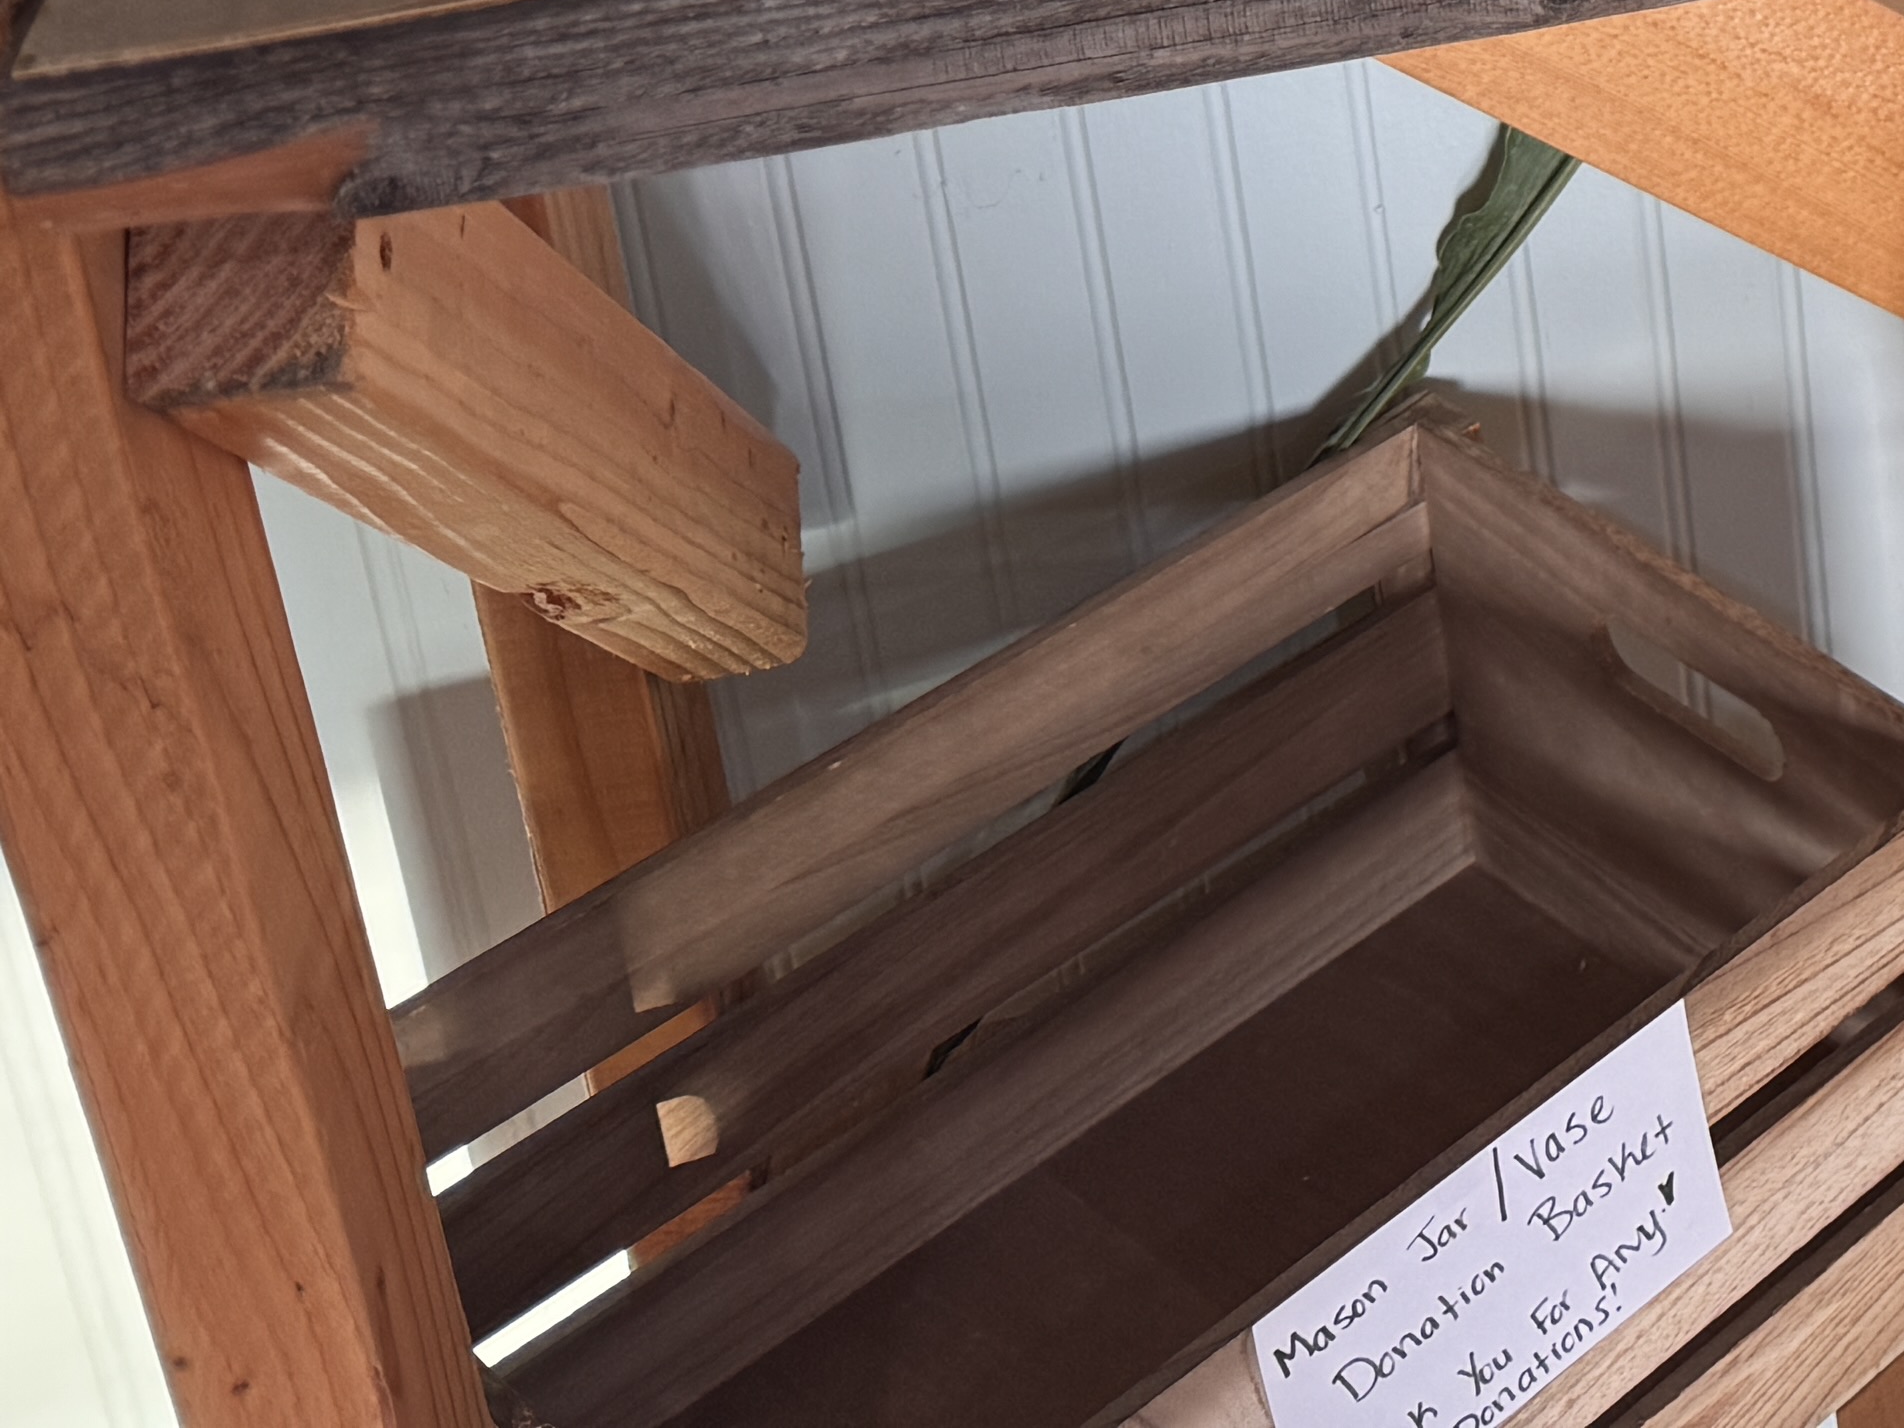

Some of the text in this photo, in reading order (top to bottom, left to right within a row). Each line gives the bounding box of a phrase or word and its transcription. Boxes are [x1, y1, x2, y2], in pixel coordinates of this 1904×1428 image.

[1273, 1279, 1388, 1379] Mason
[1331, 1258, 1505, 1404] Donation
[1457, 1348, 1513, 1397] You
[1530, 1289, 1572, 1336] For
